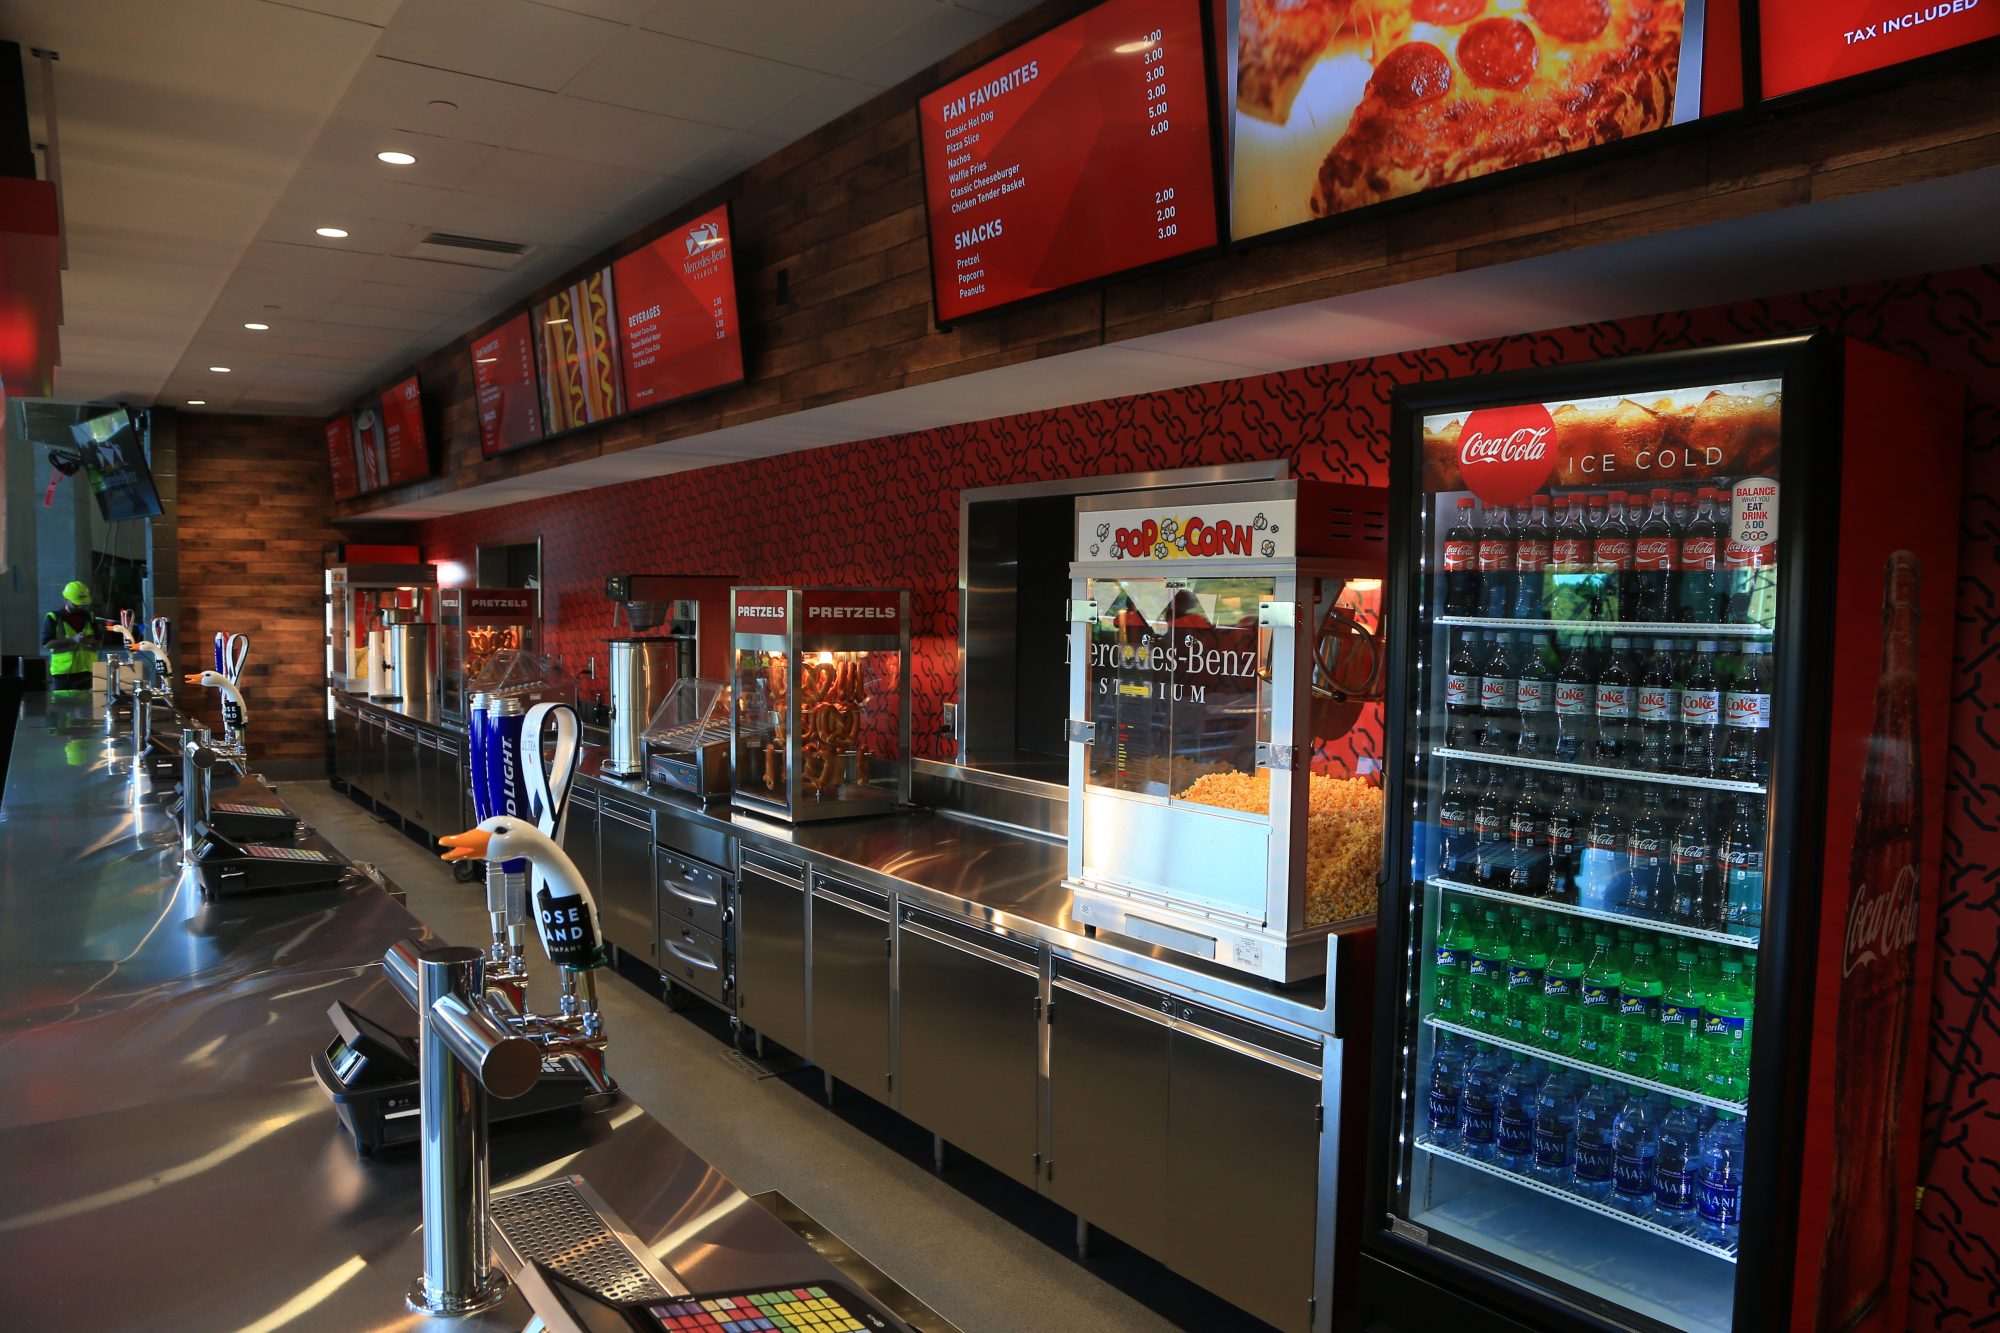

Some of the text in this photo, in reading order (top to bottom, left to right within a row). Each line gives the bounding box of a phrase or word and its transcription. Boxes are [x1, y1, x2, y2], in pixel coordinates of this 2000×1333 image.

[1844, 0, 1978, 45] TAX INCLUDED
[1143, 28, 1162, 47] 2.00
[1144, 47, 1164, 65] 3.00
[1146, 65, 1165, 83] 3.00
[943, 60, 1040, 122] FAN FAVORITES
[1147, 83, 1166, 100] 3.00
[1148, 102, 1168, 118] 5.00
[945, 110, 994, 139] Classic Hot Dog
[1150, 120, 1169, 136] 6.00
[946, 132, 980, 155] Pizza Slice
[948, 152, 971, 169] Nachos
[949, 161, 987, 184] Waffle Fries
[950, 163, 1020, 199] Classic Cheeseburger
[952, 177, 1025, 214] Chicken Tender Basket
[1155, 188, 1174, 204] 2.00
[1157, 206, 1176, 222] 2.00
[954, 218, 1003, 250] SNACKS
[1158, 224, 1177, 239] 3.00
[956, 253, 980, 270] Pretzel
[958, 268, 984, 284] Popcorn
[959, 283, 985, 299] Peanuts
[628, 304, 661, 327] BEVERAGES
[1461, 427, 1552, 465] Coca-Cola
[1568, 447, 1723, 475] ICE COLD
[1736, 486, 1776, 497] BALANCE
[1747, 503, 1762, 511] EAT
[1741, 512, 1768, 521] DRINK
[1745, 521, 1764, 529] & DO
[1115, 516, 1253, 560] POP CORN
[738, 606, 784, 618] PRETZELS
[809, 607, 896, 618] PRETZELS
[1447, 681, 1465, 690] oke
[1556, 687, 1585, 700] Coke
[1683, 695, 1716, 709] Coke
[1726, 697, 1757, 711] Coke
[502, 736, 516, 798] LIGHT
[542, 907, 580, 924] OSE
[1844, 864, 1919, 978] Coca-Cola
[547, 927, 583, 942] AND
[1510, 975, 1532, 985] Sprite
[1546, 984, 1568, 994] Sprite
[1584, 994, 1607, 1005] Sprite
[1621, 1003, 1643, 1013] Sprite
[1661, 1012, 1683, 1023] Sprite
[1705, 1021, 1726, 1033] Sprite
